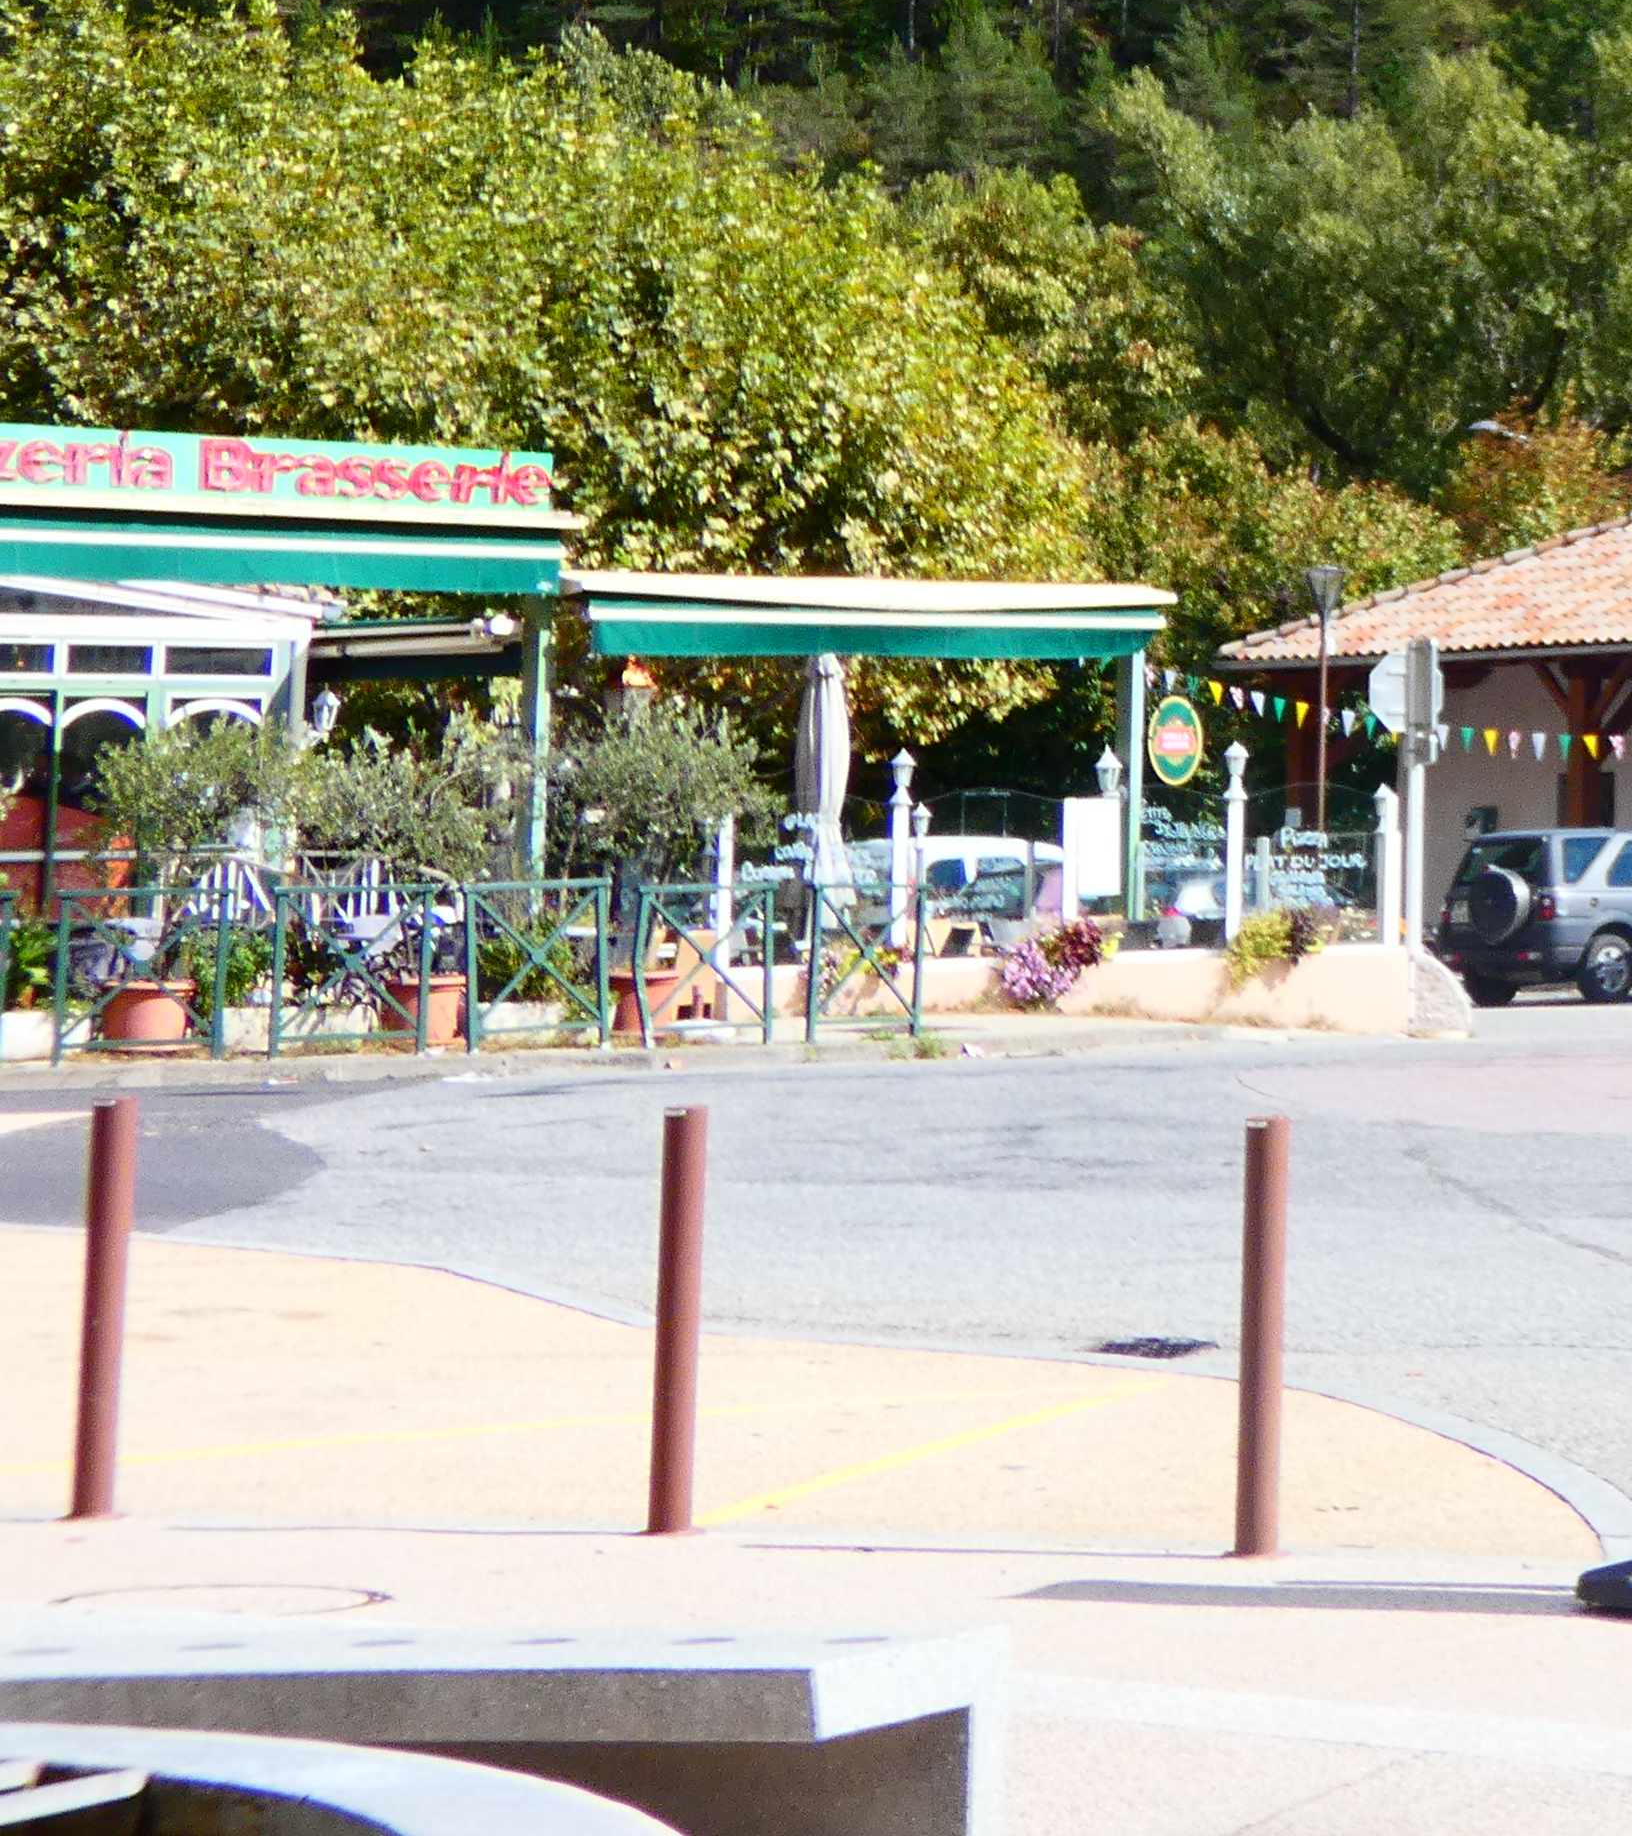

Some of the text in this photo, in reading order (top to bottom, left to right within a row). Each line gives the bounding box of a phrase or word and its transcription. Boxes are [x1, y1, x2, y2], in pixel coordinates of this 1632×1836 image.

[198, 436, 553, 507] Brasserie
[1290, 853, 1316, 870] DU
[1317, 852, 1368, 870] JOUR
